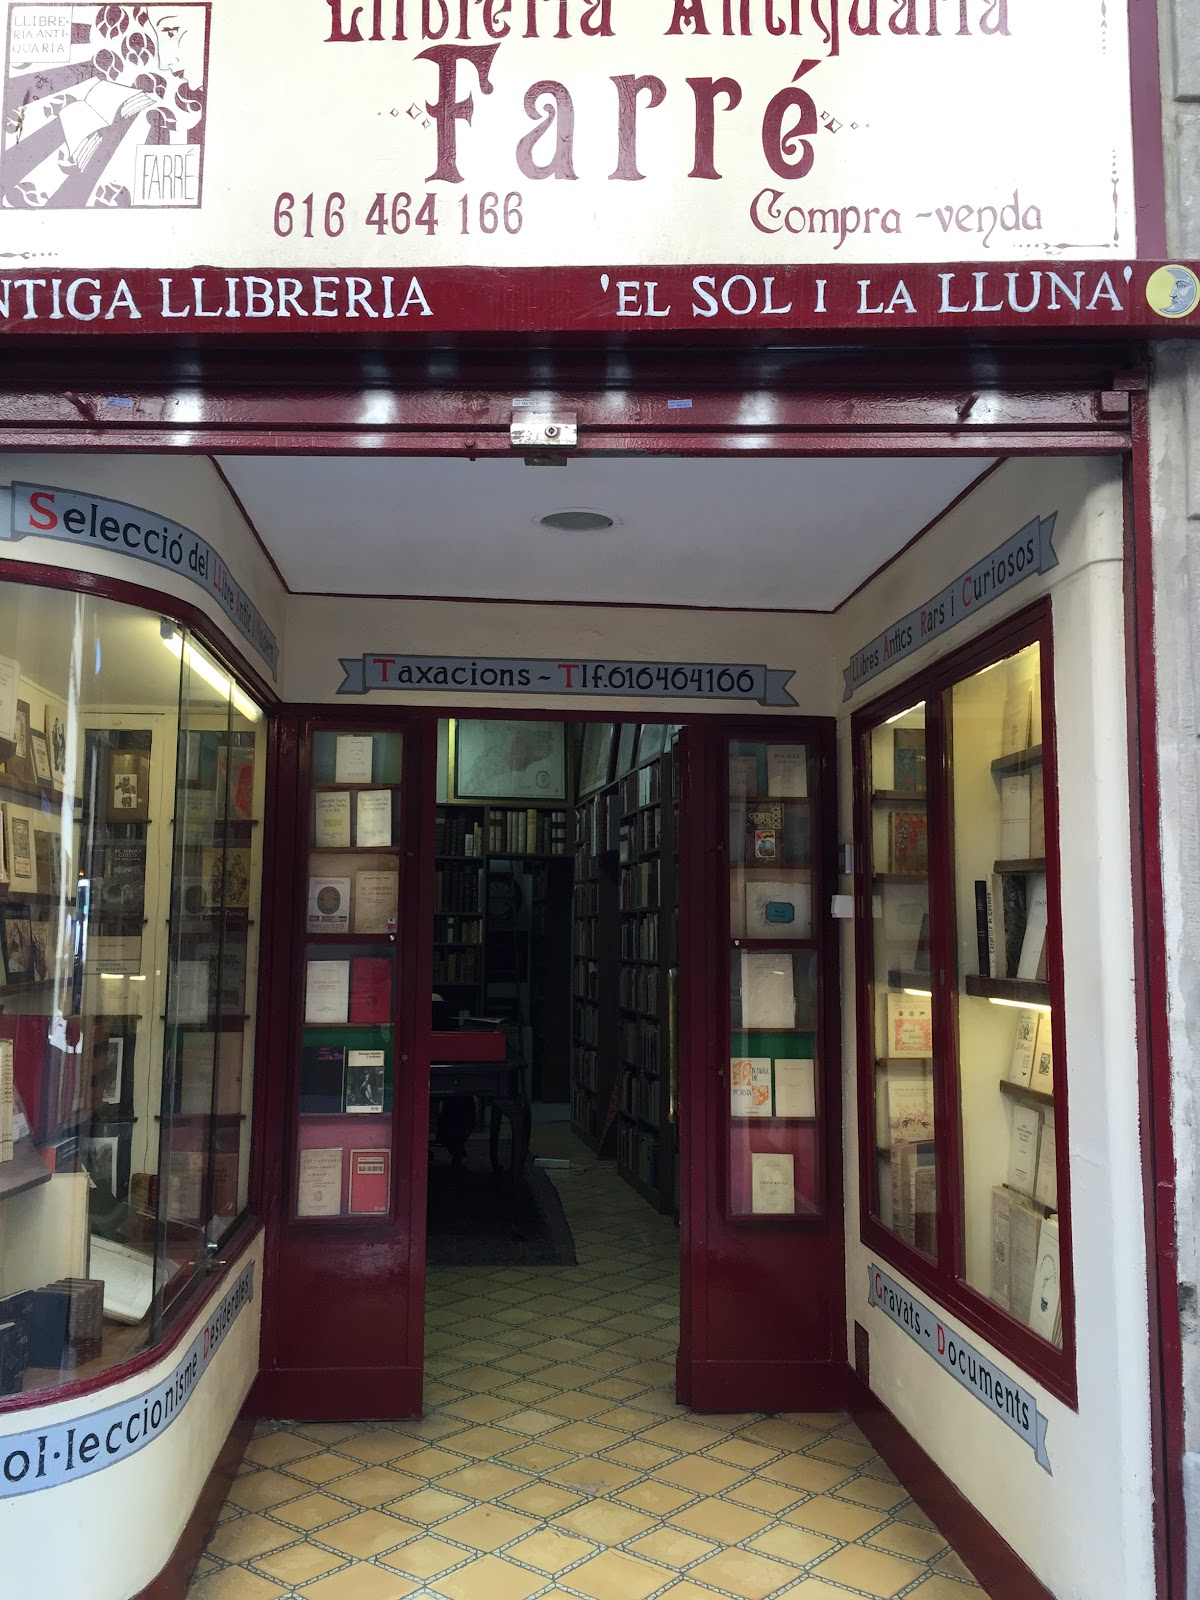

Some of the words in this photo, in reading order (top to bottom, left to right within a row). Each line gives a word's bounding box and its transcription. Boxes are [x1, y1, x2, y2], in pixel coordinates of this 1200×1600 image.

[411, 42, 822, 184] Farré
[142, 147, 196, 200] FARRÉ
[273, 191, 346, 238] 616
[365, 191, 439, 237] 464
[459, 190, 523, 236] 166
[749, 187, 903, 250] Compra
[158, 275, 434, 318] LLIBRERIA
[692, 273, 793, 318] SOL
[813, 279, 827, 315] I
[856, 279, 918, 315] LA
[28, 491, 184, 565] Selecció
[188, 541, 209, 580] del
[883, 625, 913, 662] Antics
[920, 600, 945, 638] Rars
[950, 589, 955, 617] i
[962, 537, 1035, 608] Curiosos
[372, 657, 531, 687] Taxacions
[202, 1272, 250, 1361] Desiderates
[875, 1272, 921, 1336] Gravats
[936, 1322, 1030, 1432] Documents
